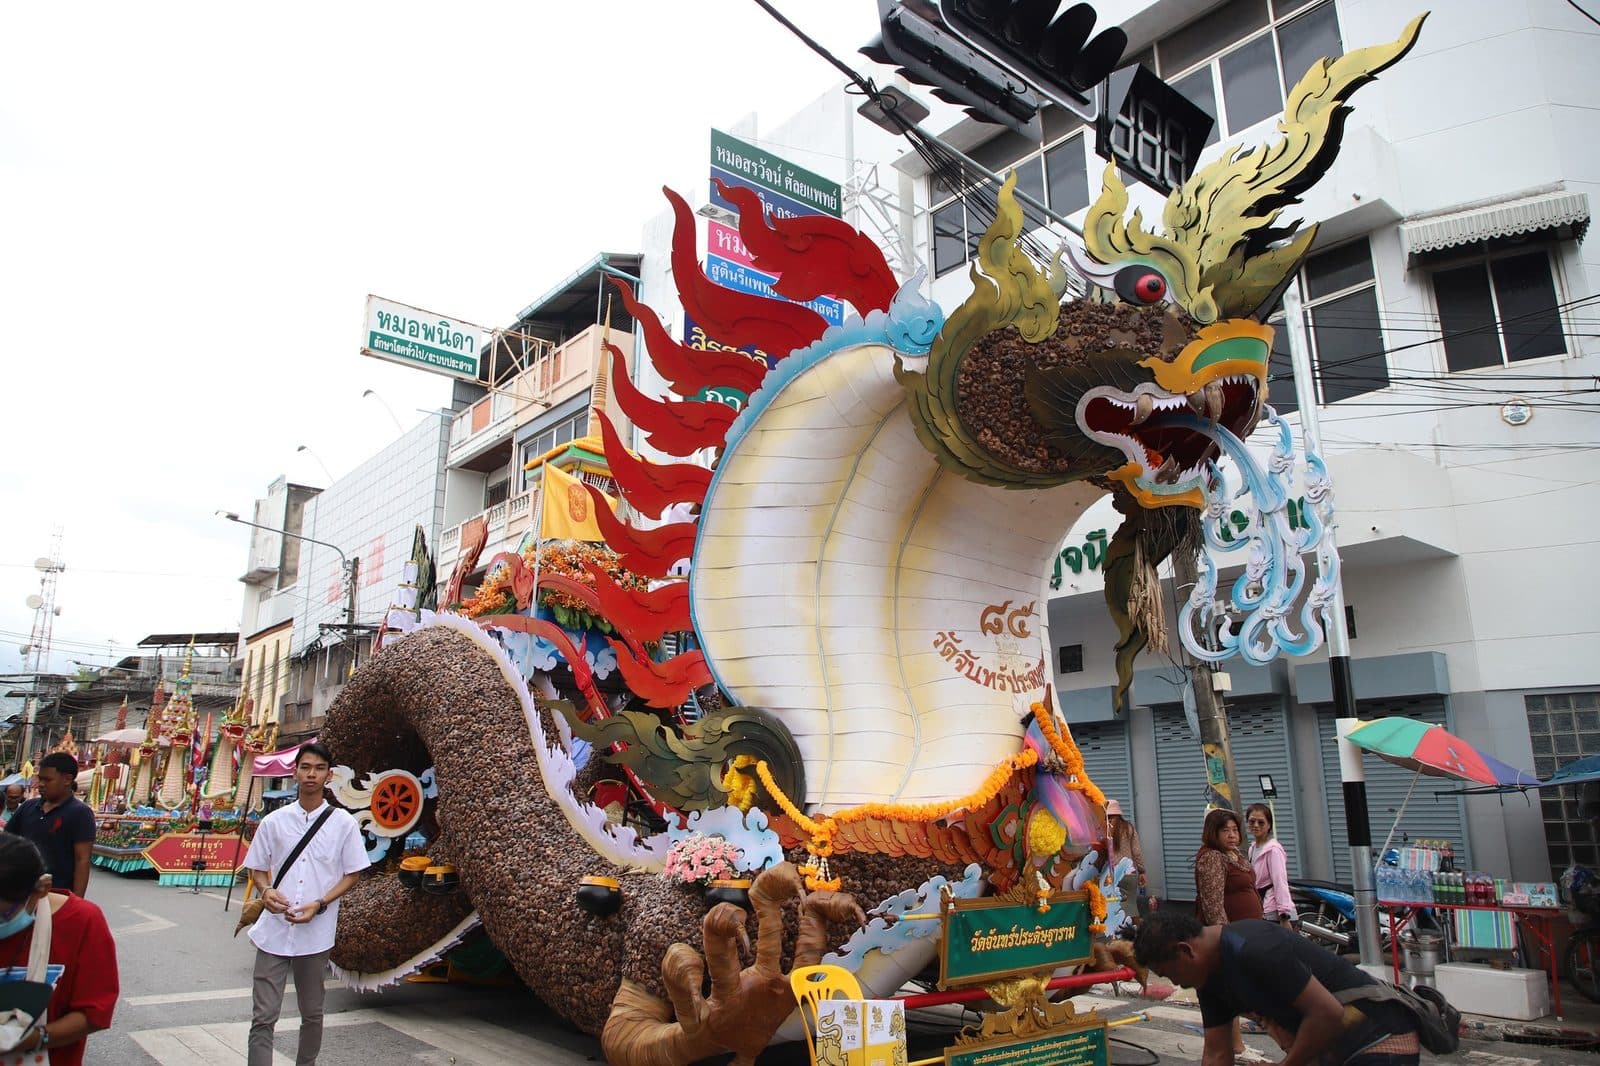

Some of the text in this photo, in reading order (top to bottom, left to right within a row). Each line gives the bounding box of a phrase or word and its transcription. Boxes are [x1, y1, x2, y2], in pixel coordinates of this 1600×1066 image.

[716, 145, 782, 187] หมอสรวัจน์
[784, 170, 838, 210] ศัลยแพทย์
[377, 310, 474, 353] หมอพนิดา
[970, 924, 1076, 953] วัดจันทร์ประดิษฐาราม
